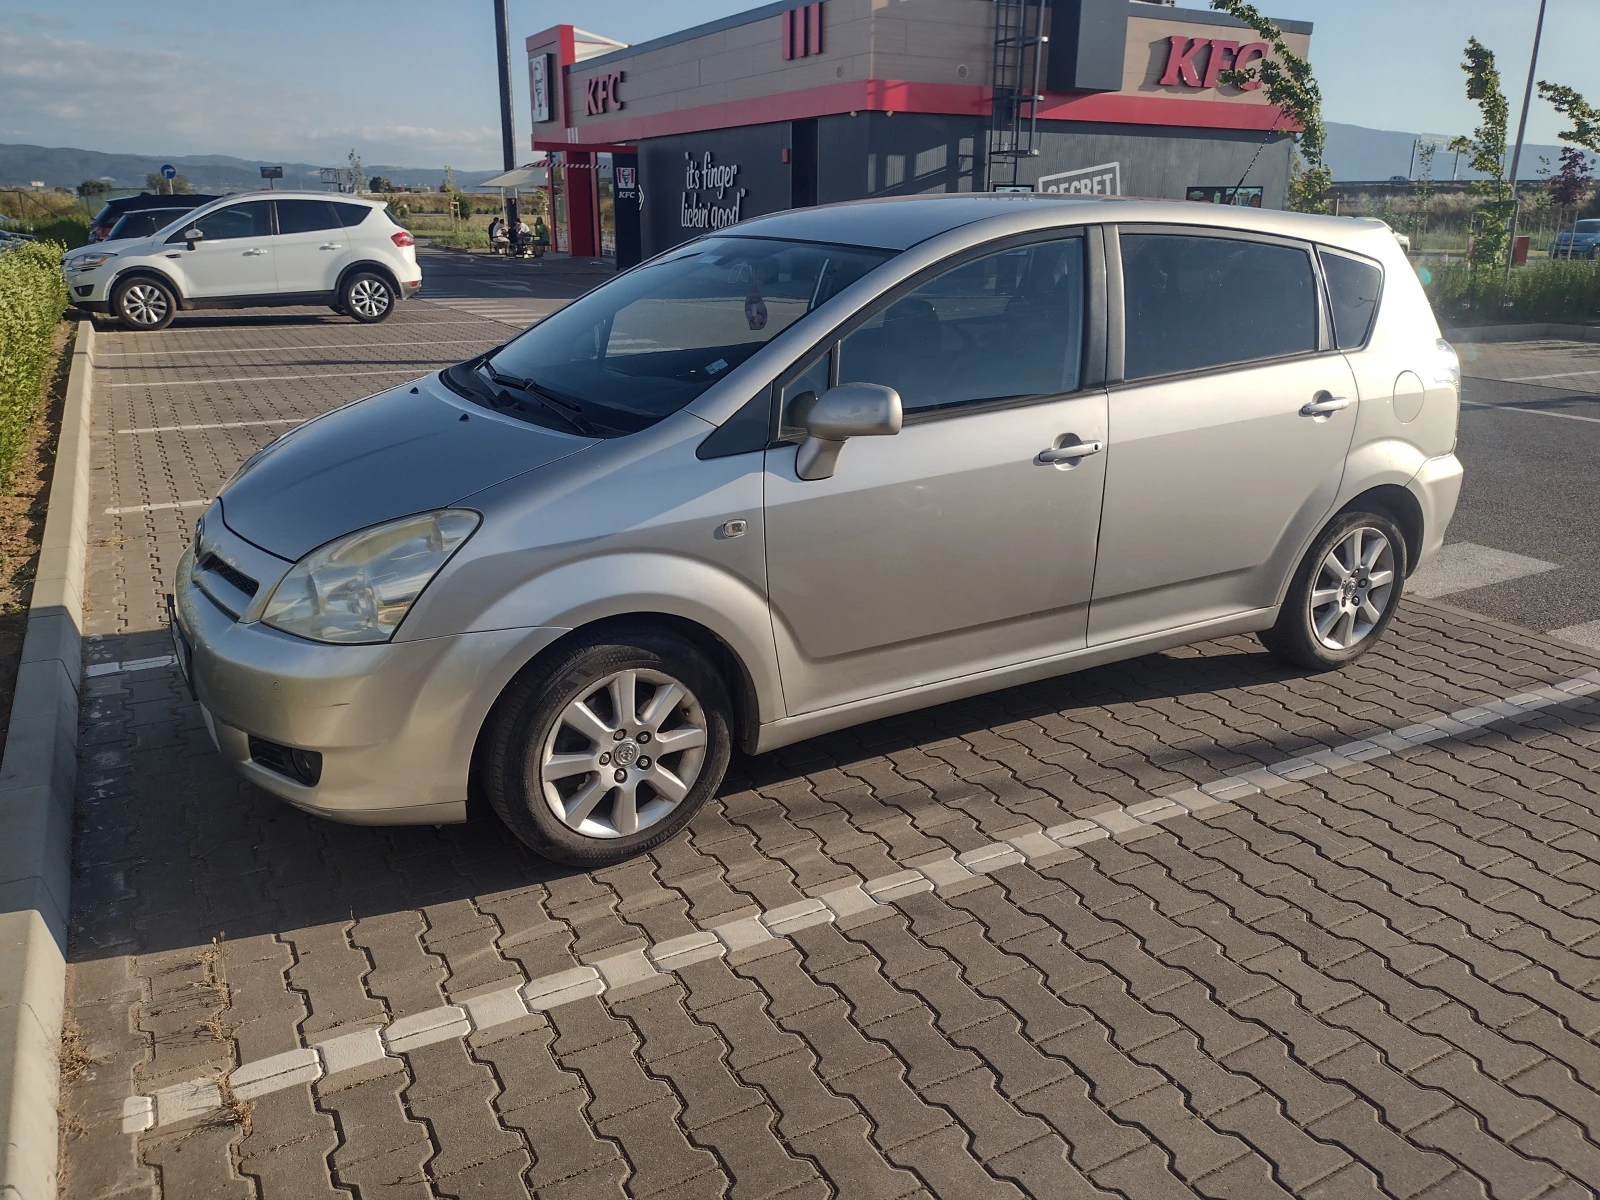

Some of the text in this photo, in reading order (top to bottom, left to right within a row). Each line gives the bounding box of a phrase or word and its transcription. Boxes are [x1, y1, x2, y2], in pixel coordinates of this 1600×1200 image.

[1160, 35, 1269, 91] KFC
[584, 70, 622, 116] KFC
[618, 191, 636, 199] KFC
[701, 150, 738, 200] finger
